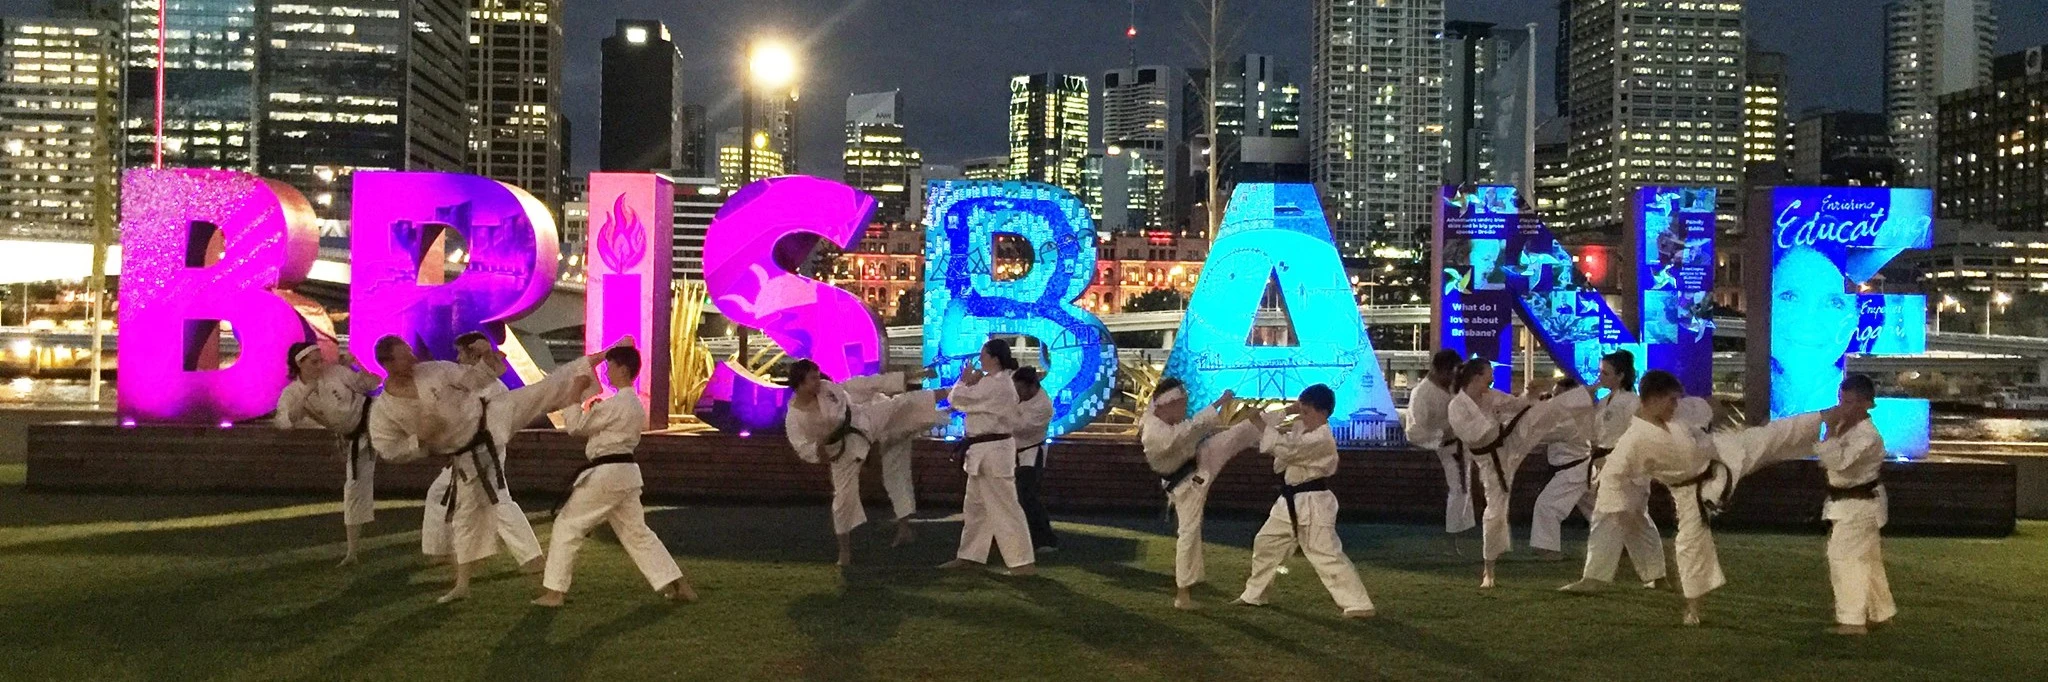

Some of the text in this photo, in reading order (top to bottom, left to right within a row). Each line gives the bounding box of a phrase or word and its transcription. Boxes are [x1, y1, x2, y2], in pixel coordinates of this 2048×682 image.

[1452, 303, 1477, 311] What
[1479, 303, 1491, 311] do
[118, 167, 1933, 459] BRISBANE
[1450, 316, 1499, 324] love about
[1451, 328, 1497, 337] Brisbane?
